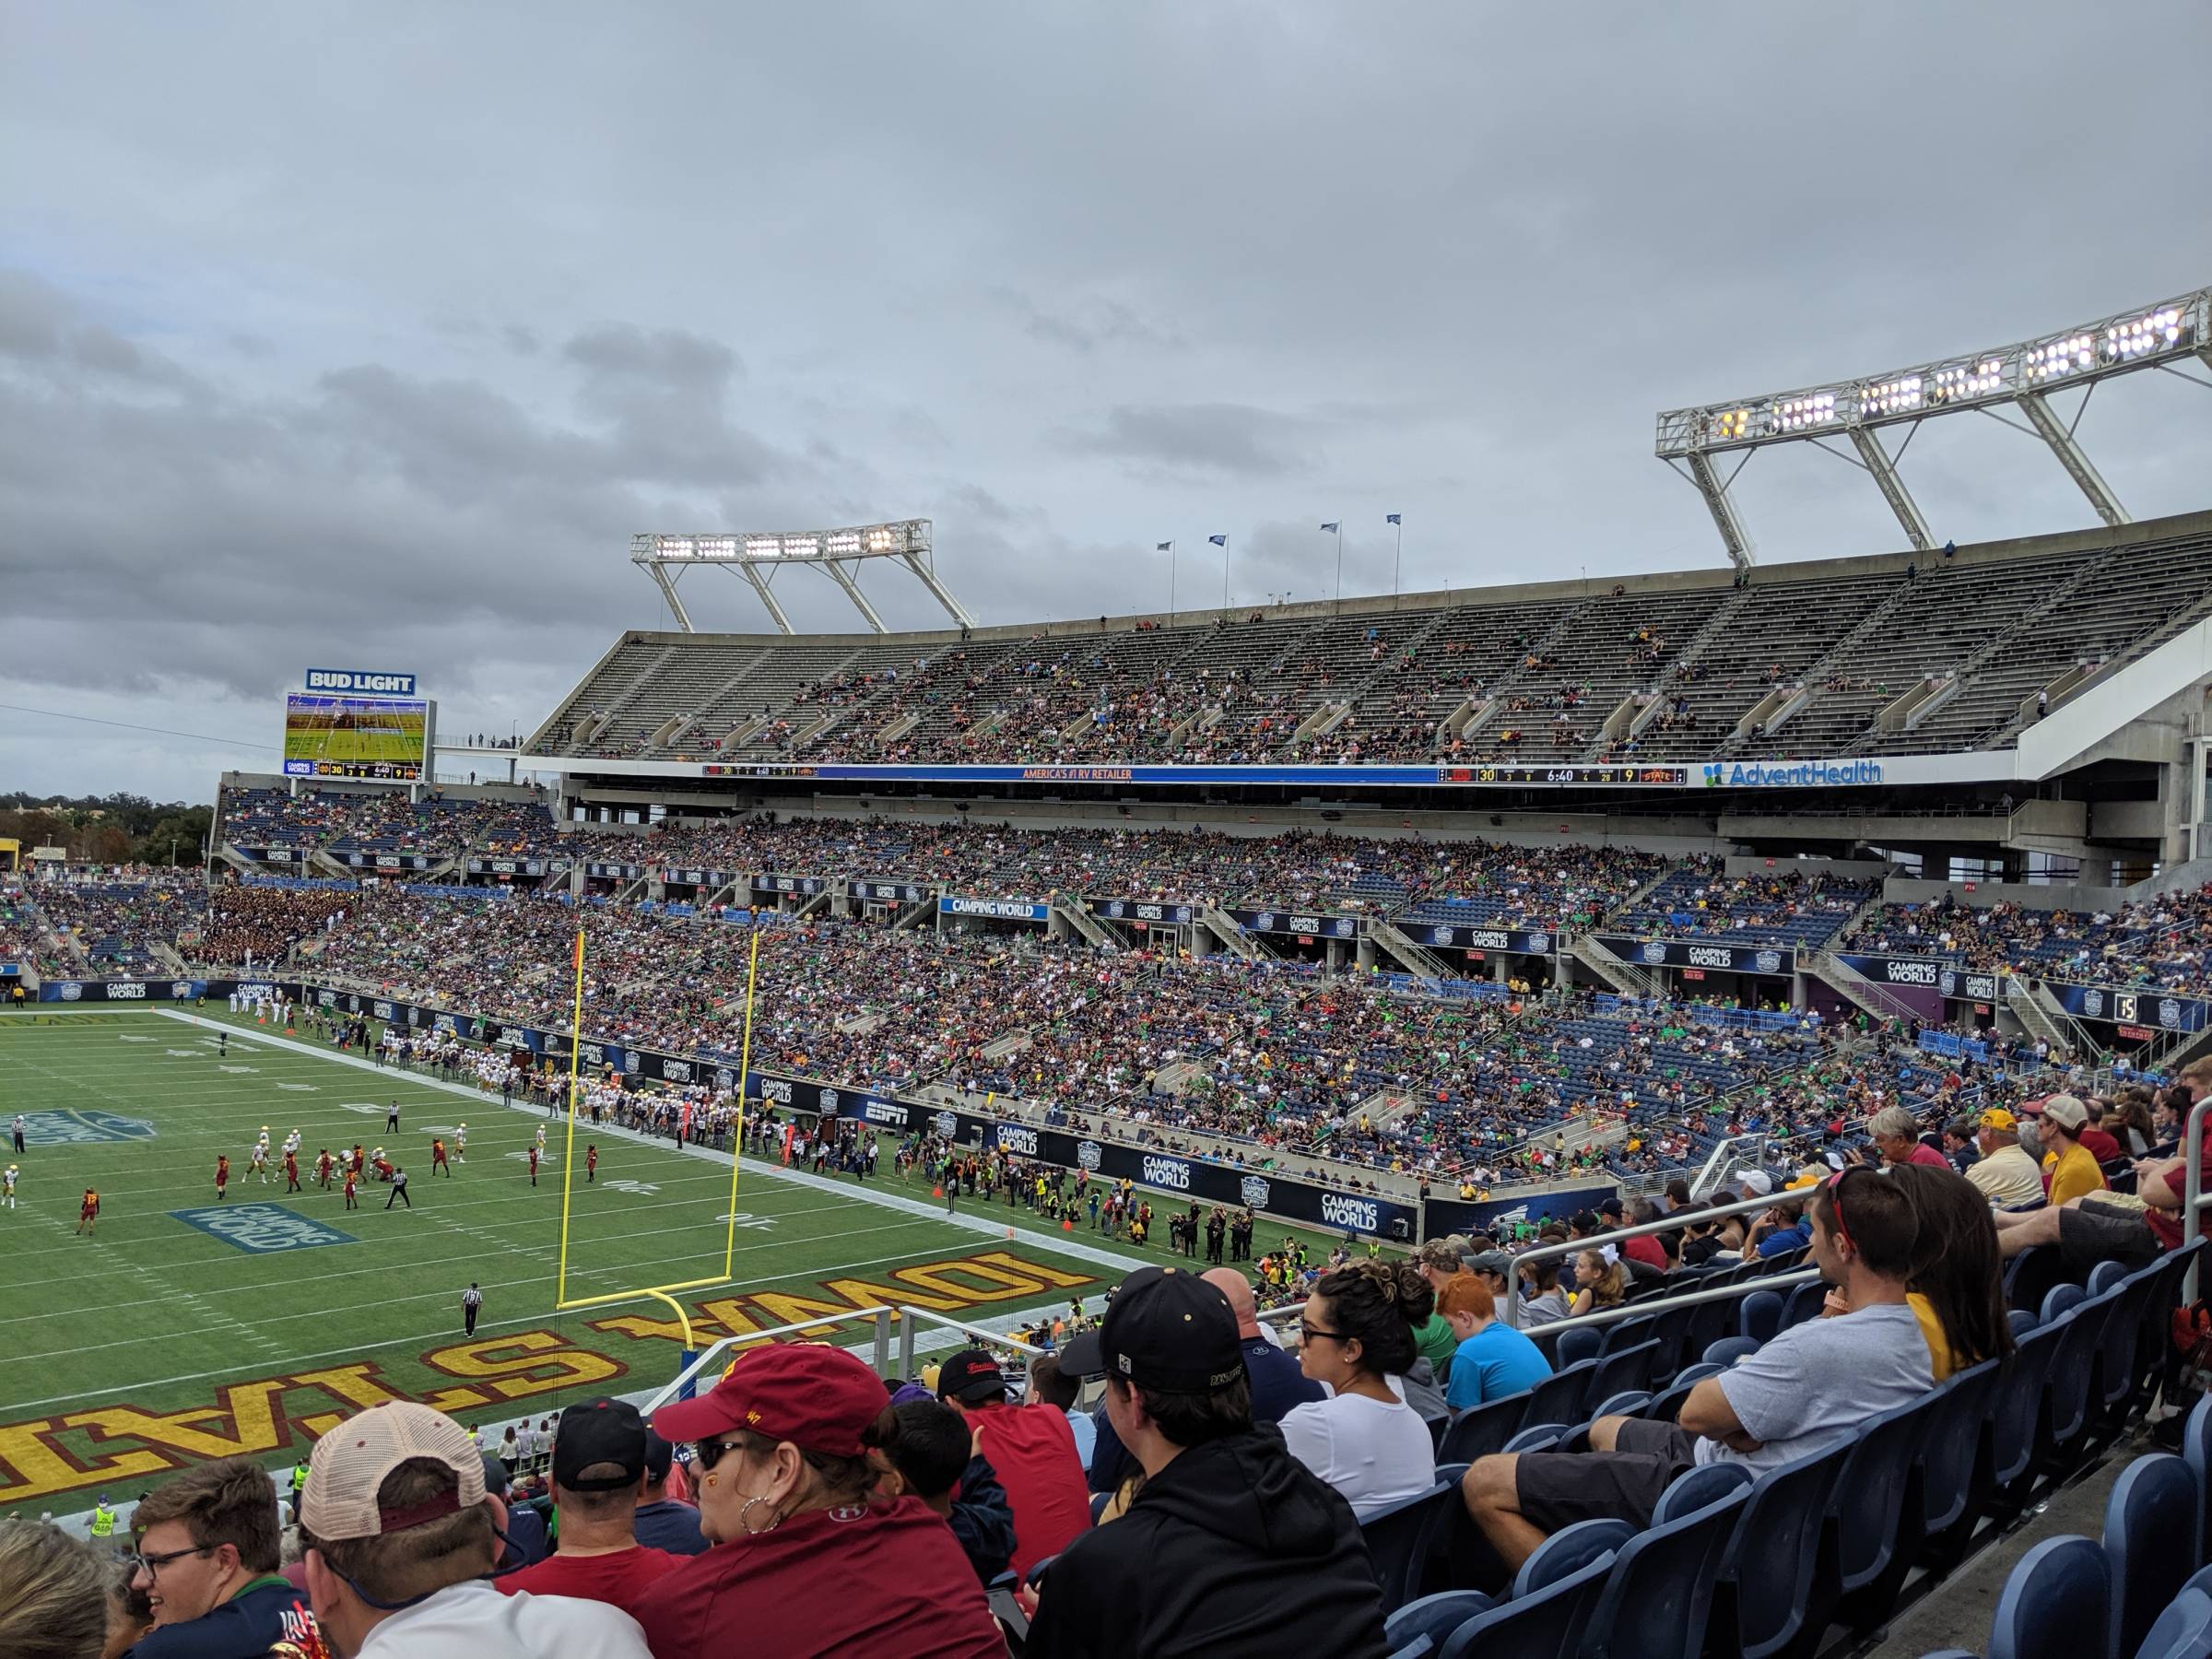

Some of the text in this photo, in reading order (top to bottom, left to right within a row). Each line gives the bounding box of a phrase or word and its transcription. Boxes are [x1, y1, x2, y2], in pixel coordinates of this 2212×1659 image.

[310, 673, 411, 691] BUD LIGHT
[1023, 769, 1067, 779] AMERICA'S
[1078, 770, 1089, 779] RV
[1092, 770, 1132, 779] RETAILER
[1480, 770, 1494, 781] 30
[1548, 771, 1573, 782] 6:40
[1626, 770, 1633, 782] 9
[1644, 771, 1670, 781] STATE
[1729, 760, 1880, 785] AdventHealth
[952, 900, 1034, 917] CAMPING WORLD
[1137, 911, 1162, 919] WORLD
[1290, 916, 1319, 925] CAMPING
[1290, 924, 1319, 933] WORLD
[1473, 931, 1508, 940] CAMPING
[1474, 938, 1508, 947] WORLD
[1688, 947, 1731, 958] CAMPING
[1690, 955, 1731, 967] WORLD
[1888, 962, 1936, 973] CAMPING
[1888, 970, 1936, 983] WORLD
[1966, 976, 1993, 989] CAMPING
[107, 982, 146, 991] CAMPING
[1967, 985, 1993, 999] WORLD
[107, 990, 145, 999] WORLD
[373, 1001, 392, 1009] CAMPING
[2123, 999, 2134, 1018] 15
[374, 1008, 392, 1018] WORLD
[435, 1013, 454, 1024] CAMPING
[501, 1027, 524, 1038] CAMPING
[578, 1042, 603, 1054] CAMPING
[664, 1060, 690, 1072] CAMPING
[761, 1078, 792, 1093] CAMPING
[761, 1088, 792, 1103] WORLD
[865, 1101, 908, 1124] ESPN
[997, 1125, 1037, 1143] CAMPING
[998, 1135, 1037, 1155] WORLD
[1144, 1156, 1189, 1176] CAMPING
[1144, 1169, 1189, 1189] WORLD
[603, 1180, 662, 1195] 20
[1244, 1183, 1265, 1193] CAMPING
[1245, 1189, 1265, 1199] WORLD
[1322, 1194, 1377, 1216] CAMPING
[715, 1213, 779, 1231] 10
[1322, 1206, 1377, 1230] WORLD
[189, 1209, 298, 1248] WORLD
[233, 1206, 339, 1244] CAMPING
[586, 1252, 1103, 1351] IOWA
